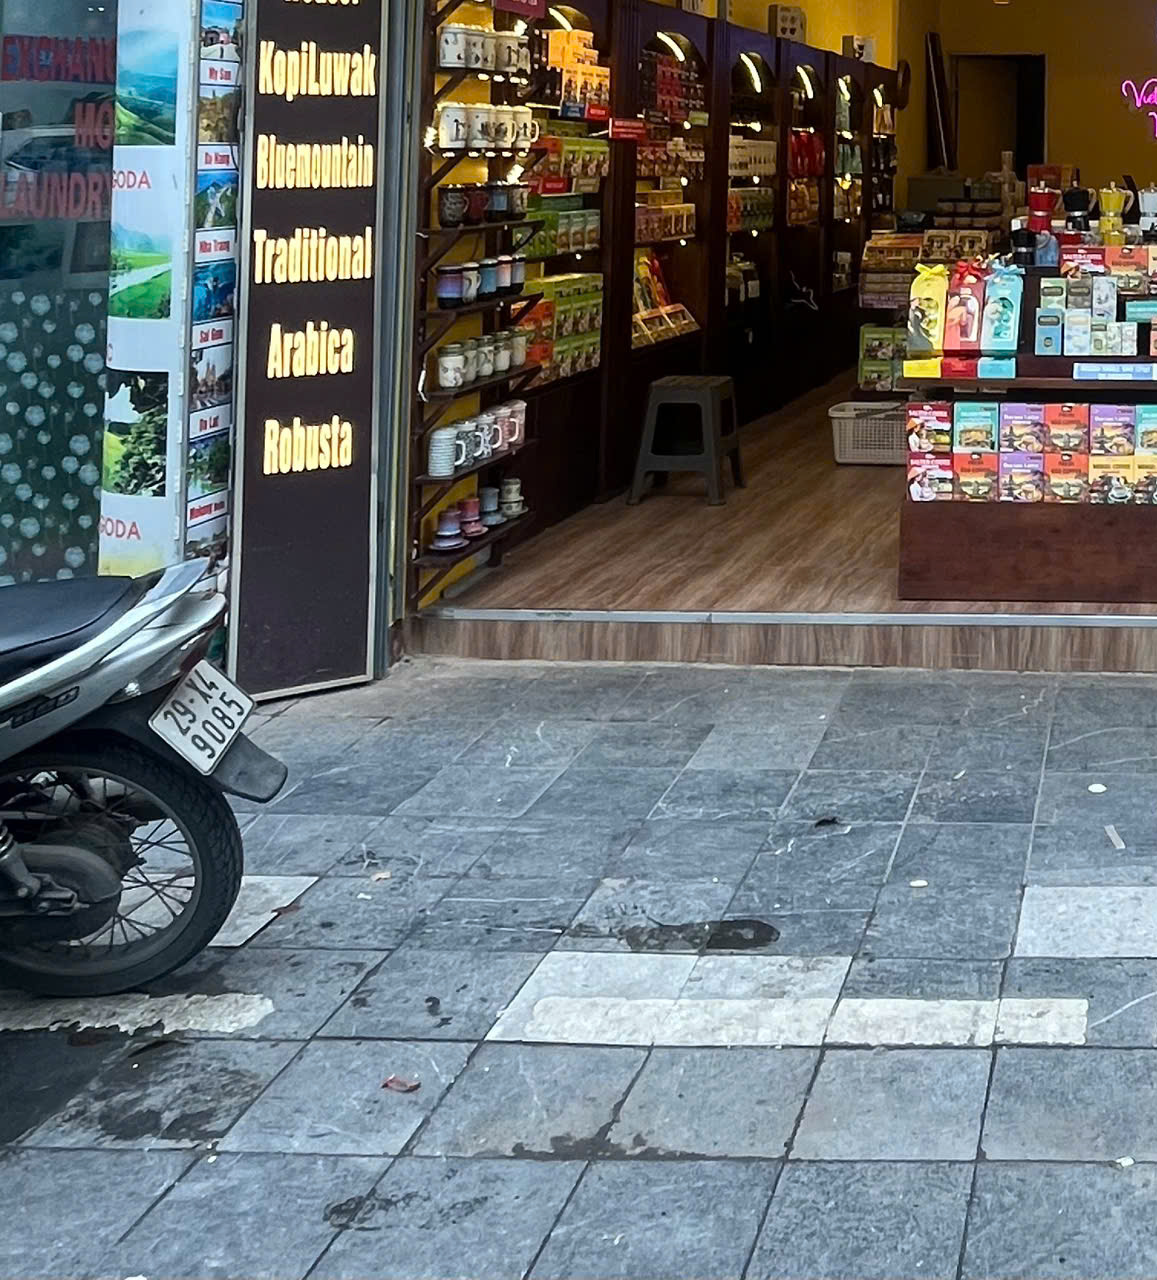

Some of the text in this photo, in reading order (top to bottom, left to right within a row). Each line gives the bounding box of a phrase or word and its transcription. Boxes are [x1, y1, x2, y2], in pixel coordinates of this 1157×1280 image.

[2, 36, 117, 82] EXCHAN
[259, 41, 377, 102] KopiLuwak
[257, 133, 374, 190] Bluemountain
[0, 171, 112, 219] LAUNDR
[253, 227, 373, 284] Traditional
[267, 321, 354, 379] Arabica
[263, 415, 353, 476] Robusta
[191, 691, 245, 760] 9085
